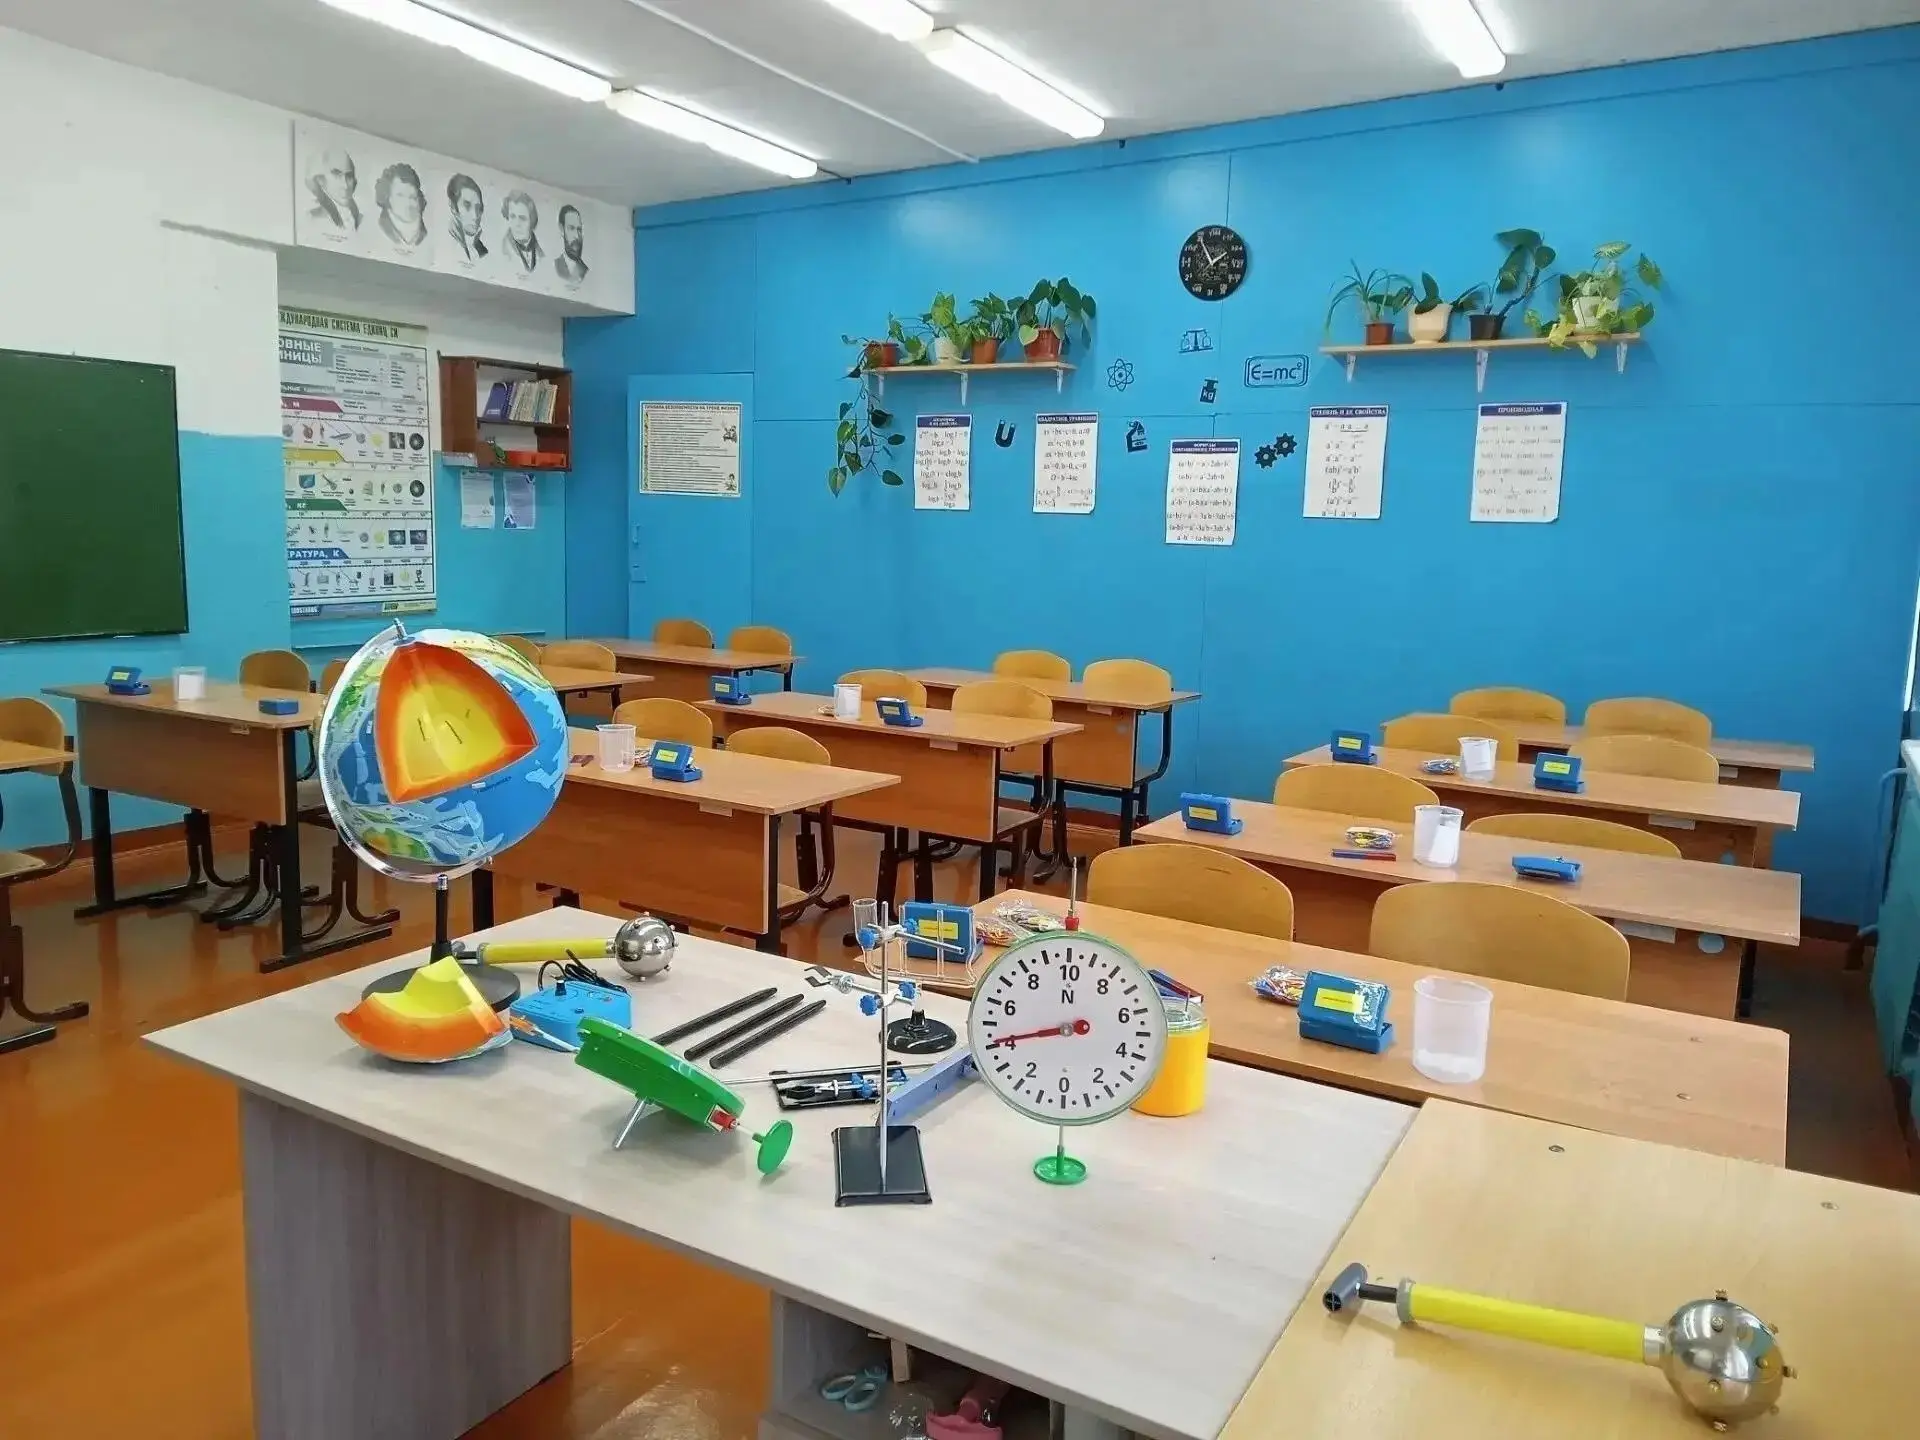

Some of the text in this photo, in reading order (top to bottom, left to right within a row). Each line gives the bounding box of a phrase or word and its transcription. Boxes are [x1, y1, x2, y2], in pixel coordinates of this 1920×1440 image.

[331, 318, 361, 334] СИСТЕМА
[364, 323, 388, 338] ЕДИНИЦ
[390, 328, 399, 338] СИ
[1202, 390, 1214, 400] kg
[1355, 408, 1386, 416] СВОЙСТВА
[1060, 965, 1080, 981] 10
[1027, 974, 1040, 990] 8
[1097, 979, 1109, 995] 8
[1061, 990, 1074, 1004] N
[1004, 1000, 1016, 1016] 6
[1118, 1008, 1130, 1023] 6
[1004, 1035, 1017, 1050] 4
[1115, 1043, 1128, 1058] 4
[1025, 1062, 1037, 1078] 2
[1092, 1068, 1104, 1083] 2
[1059, 1077, 1070, 1092] 0
